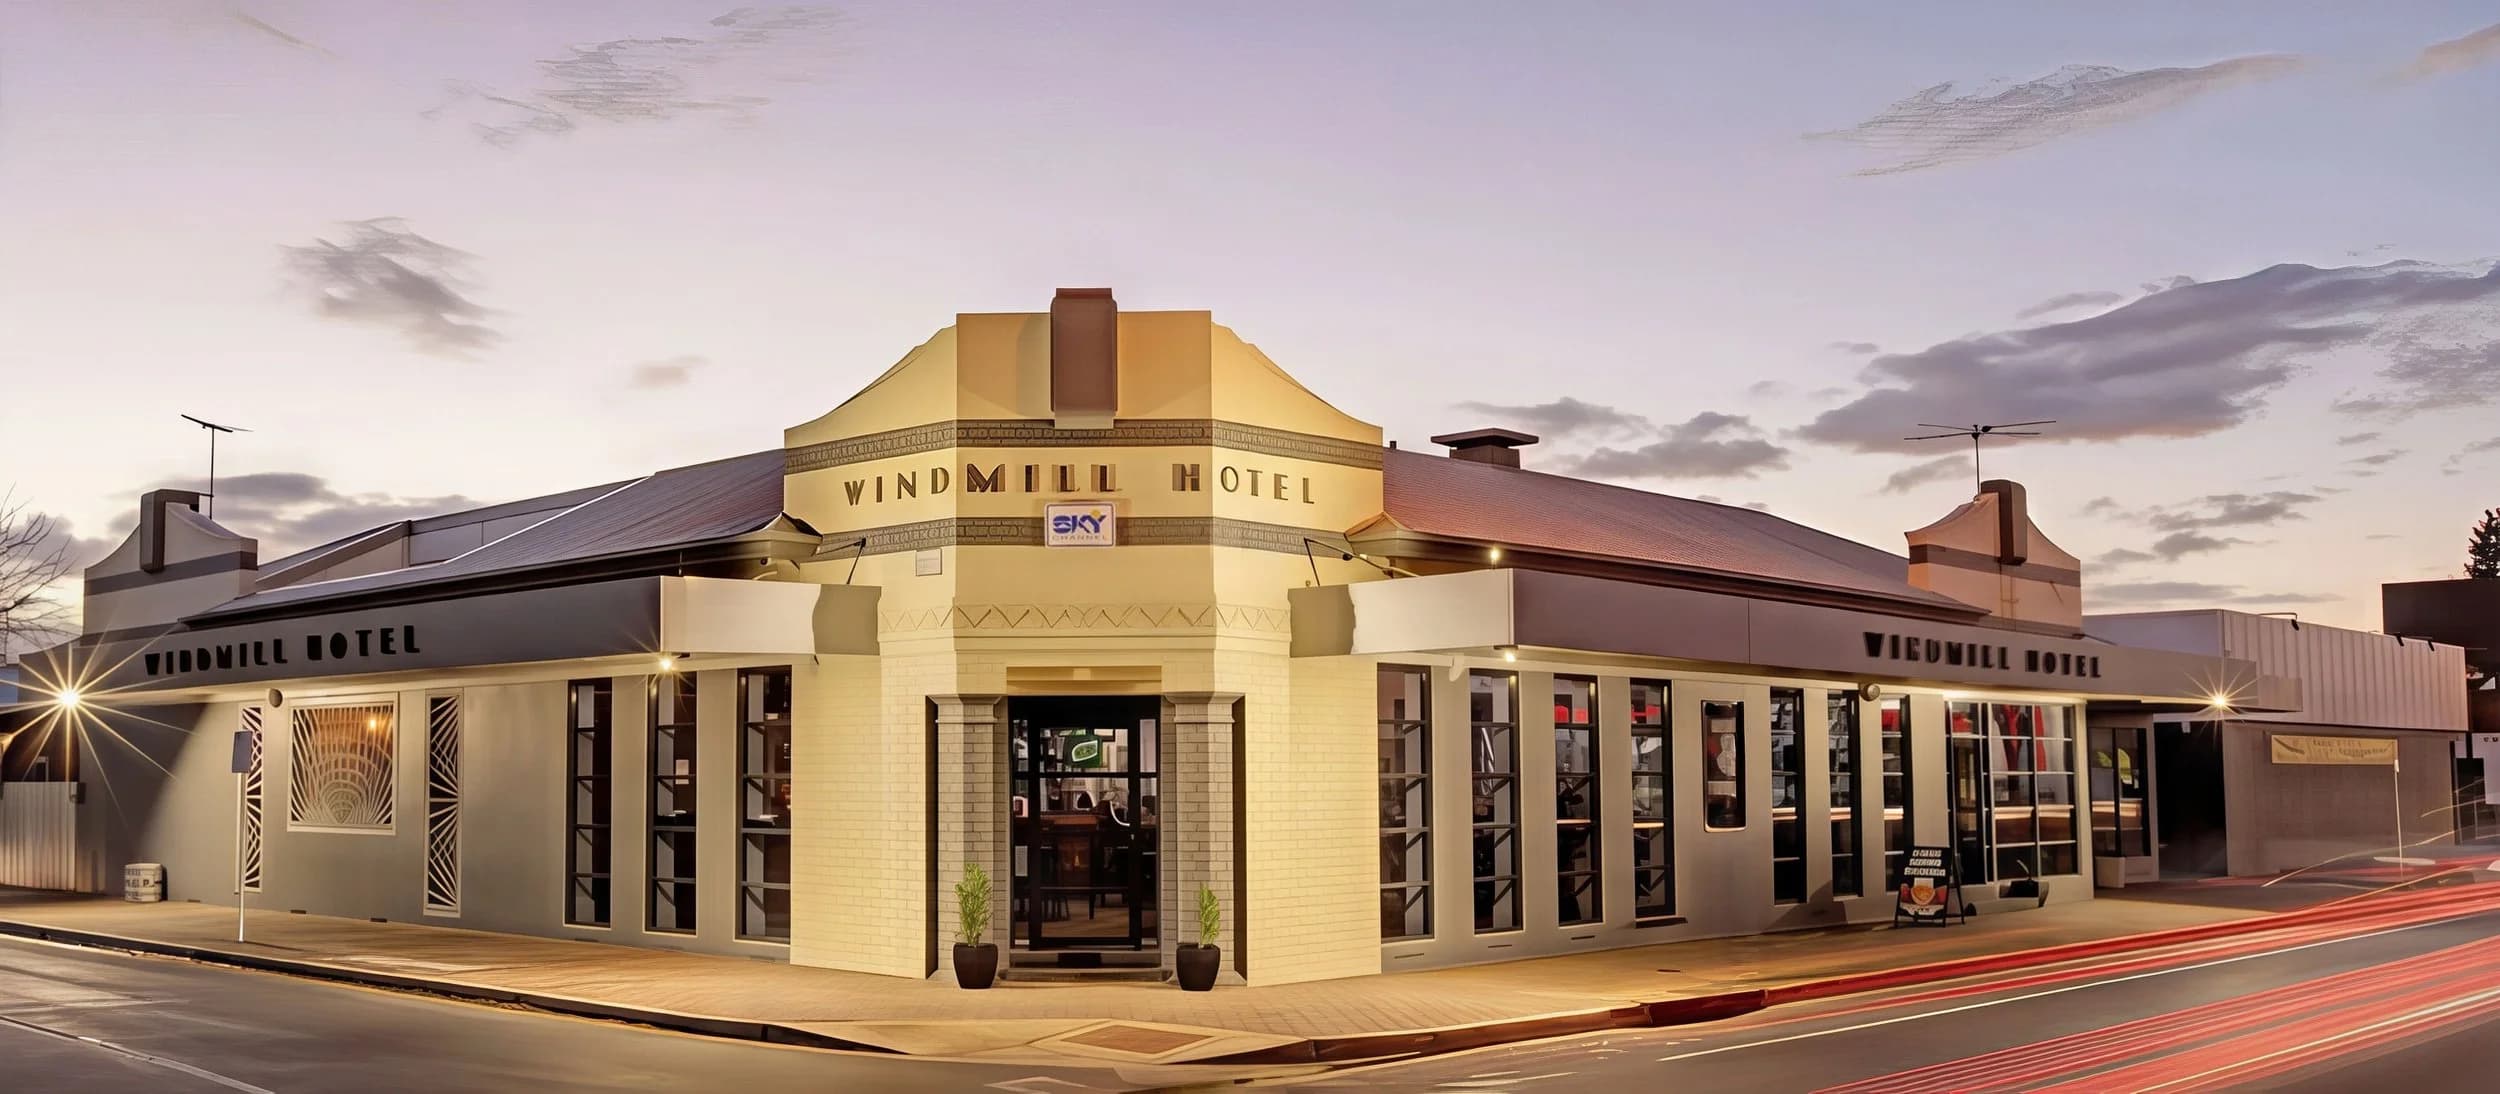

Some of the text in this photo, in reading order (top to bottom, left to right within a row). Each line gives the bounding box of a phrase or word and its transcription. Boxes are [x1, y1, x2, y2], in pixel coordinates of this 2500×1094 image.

[844, 463, 1315, 506] WINDMILL HOTEL
[1053, 515, 1106, 534] SKY
